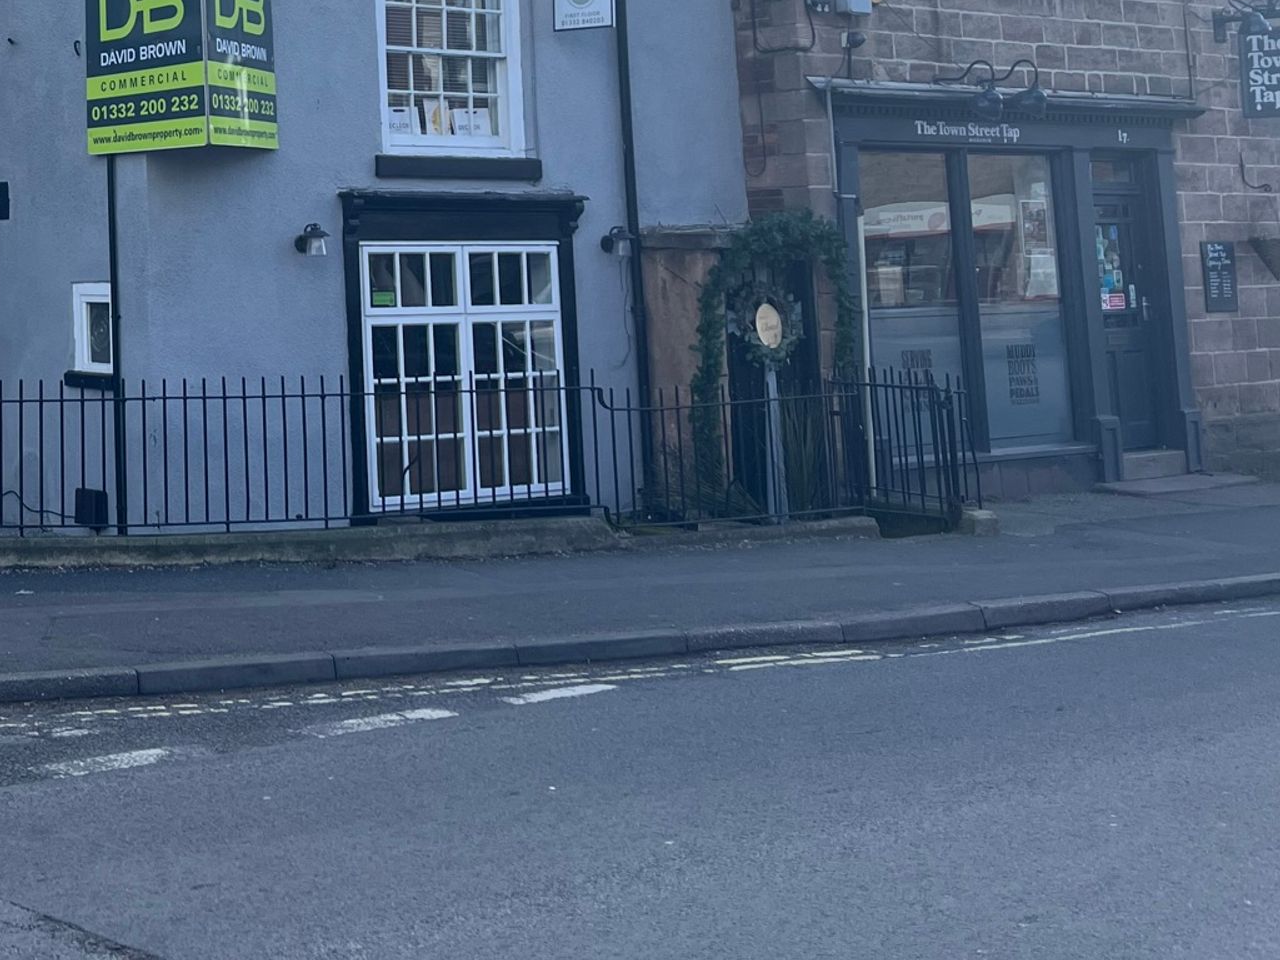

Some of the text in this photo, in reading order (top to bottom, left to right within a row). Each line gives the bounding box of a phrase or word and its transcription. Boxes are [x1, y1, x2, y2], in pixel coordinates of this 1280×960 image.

[100, 39, 187, 67] DAVID BROWN
[216, 38, 267, 61] DAVID BROWN
[1248, 52, 1280, 69] To
[101, 70, 187, 92] COMMERCIAL
[217, 68, 268, 87] COMMRCIAL
[1249, 69, 1280, 85] Str
[92, 94, 199, 121] 01332 200 232
[212, 93, 241, 111] 01332
[261, 100, 275, 115] 232
[93, 128, 200, 144] www.davidbrownproperty.com
[914, 120, 1020, 143] The Town Street Tap
